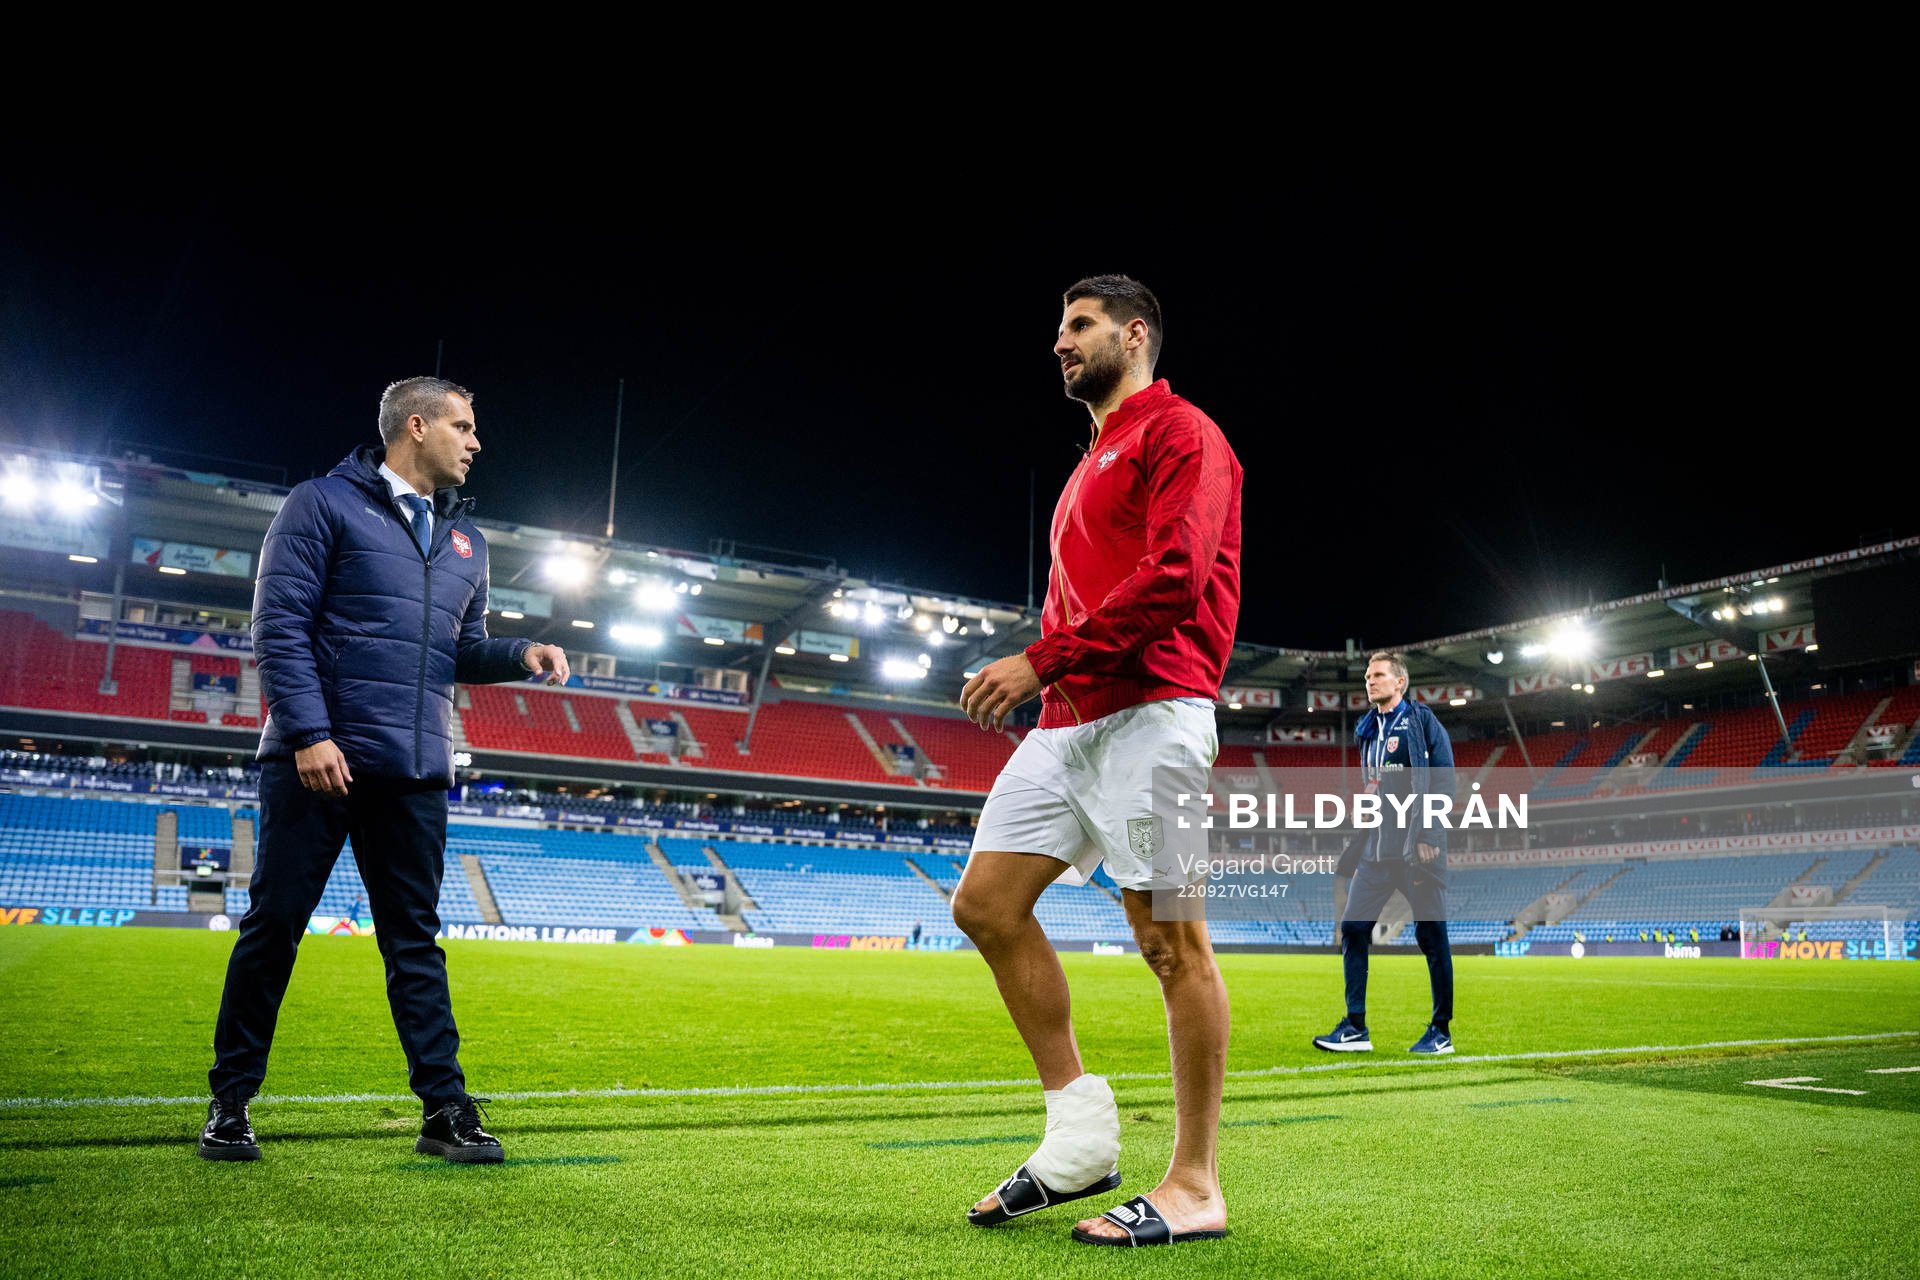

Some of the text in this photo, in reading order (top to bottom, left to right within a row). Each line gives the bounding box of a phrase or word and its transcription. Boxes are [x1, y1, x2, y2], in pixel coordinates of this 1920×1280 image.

[1592, 656, 1649, 682] VG
[1221, 687, 1273, 706] VG
[1272, 728, 1332, 742] VG
[42, 906, 137, 928] SLEEP
[447, 923, 538, 942] NATIONS
[542, 926, 618, 944] LEAGUE
[812, 934, 850, 950] EAT
[850, 935, 906, 951] MOVE
[1780, 941, 1844, 961] MOVE
